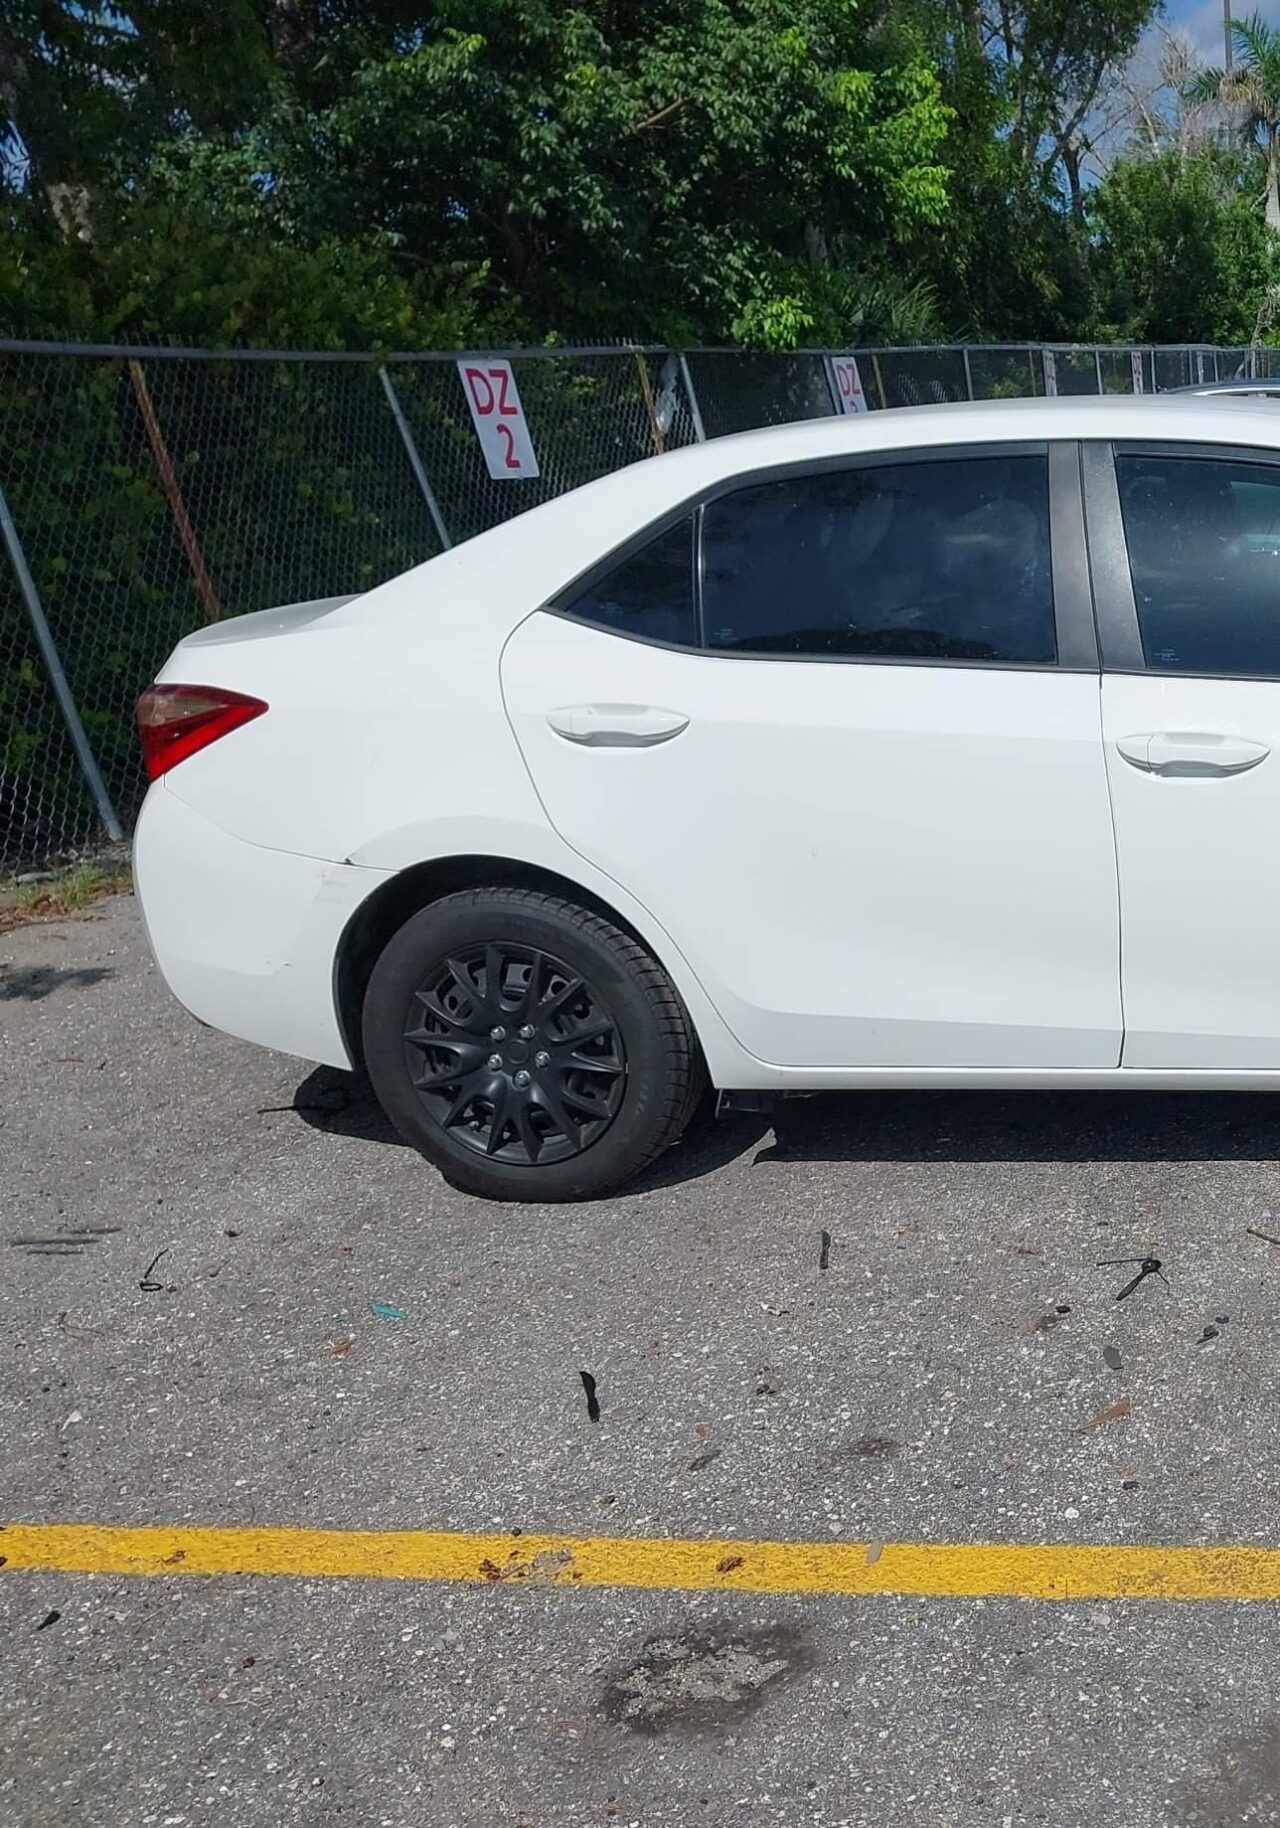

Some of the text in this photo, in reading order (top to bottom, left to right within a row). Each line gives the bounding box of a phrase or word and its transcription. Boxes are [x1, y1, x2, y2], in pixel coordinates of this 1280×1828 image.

[465, 368, 518, 415] DZ
[836, 363, 861, 396] DZ
[496, 423, 521, 469] 2
